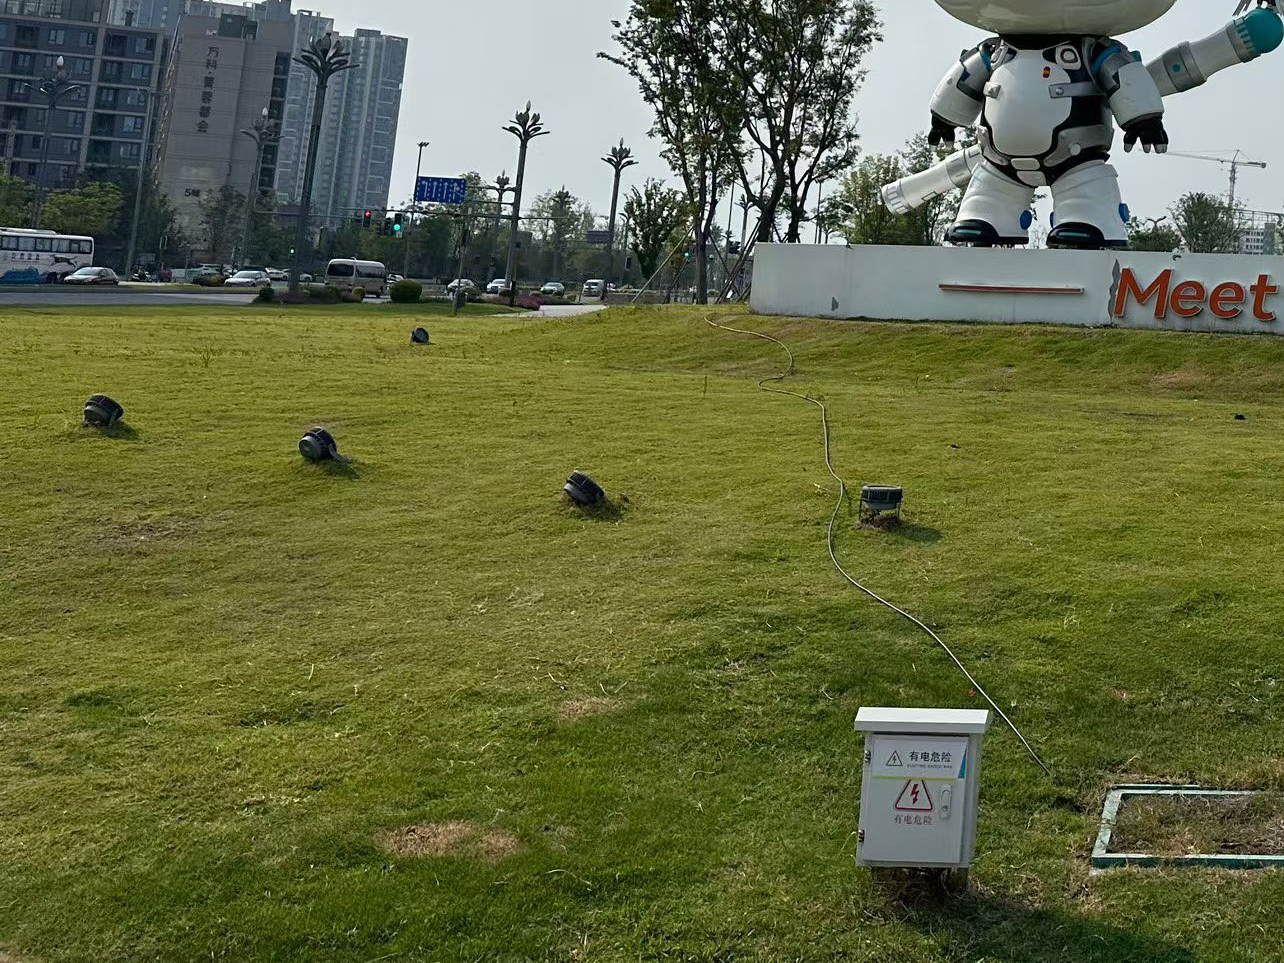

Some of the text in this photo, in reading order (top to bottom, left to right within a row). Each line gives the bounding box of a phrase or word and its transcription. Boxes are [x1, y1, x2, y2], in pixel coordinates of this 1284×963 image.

[1113, 267, 1277, 322] Meet
[909, 751, 952, 763] 有电危险
[895, 814, 933, 826] 有电危险
